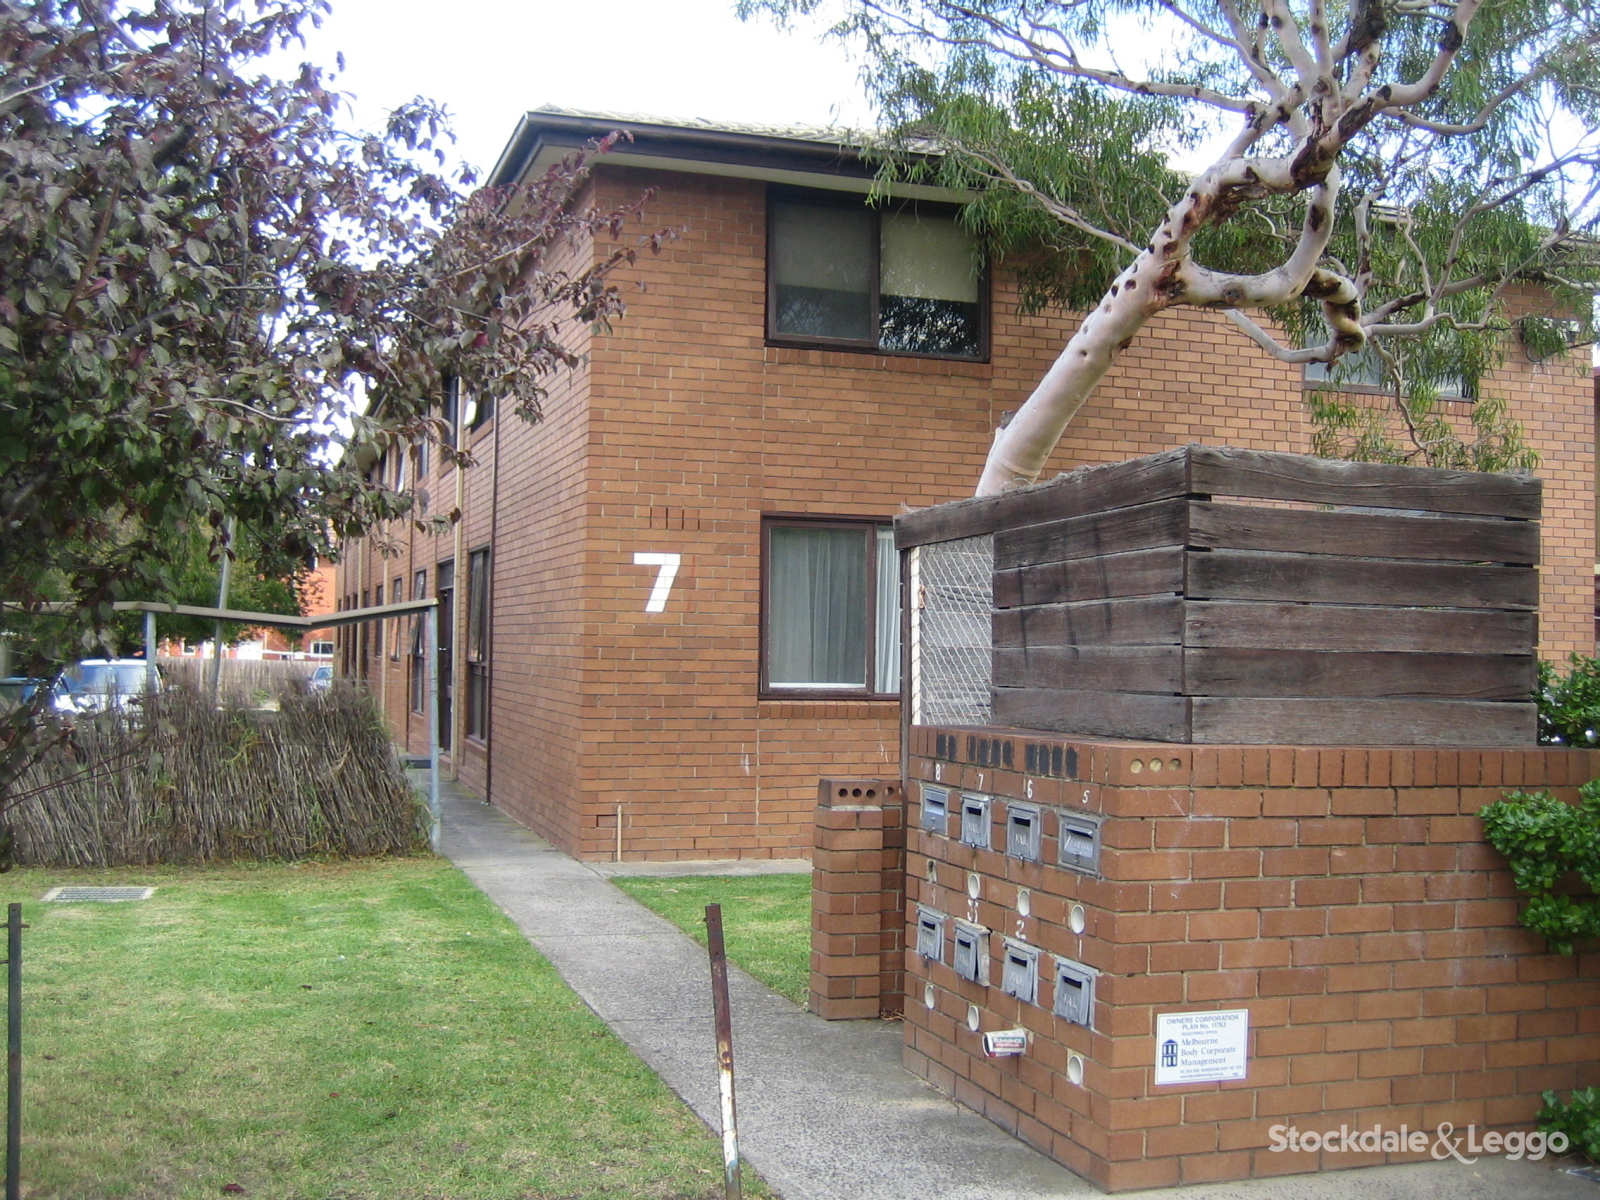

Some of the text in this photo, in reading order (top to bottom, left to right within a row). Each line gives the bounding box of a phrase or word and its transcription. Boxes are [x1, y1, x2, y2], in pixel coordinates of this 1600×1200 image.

[633, 552, 681, 612] 7
[935, 763, 942, 781] 8
[978, 773, 984, 790] 7
[1026, 779, 1034, 799] 6
[1082, 789, 1090, 804] 5
[1015, 920, 1027, 940] 2
[1195, 1015, 1239, 1023] CORPORATION
[1181, 1037, 1219, 1046] Melbourne
[1181, 1046, 1237, 1057] Body Corporate
[1180, 1058, 1226, 1067] Management
